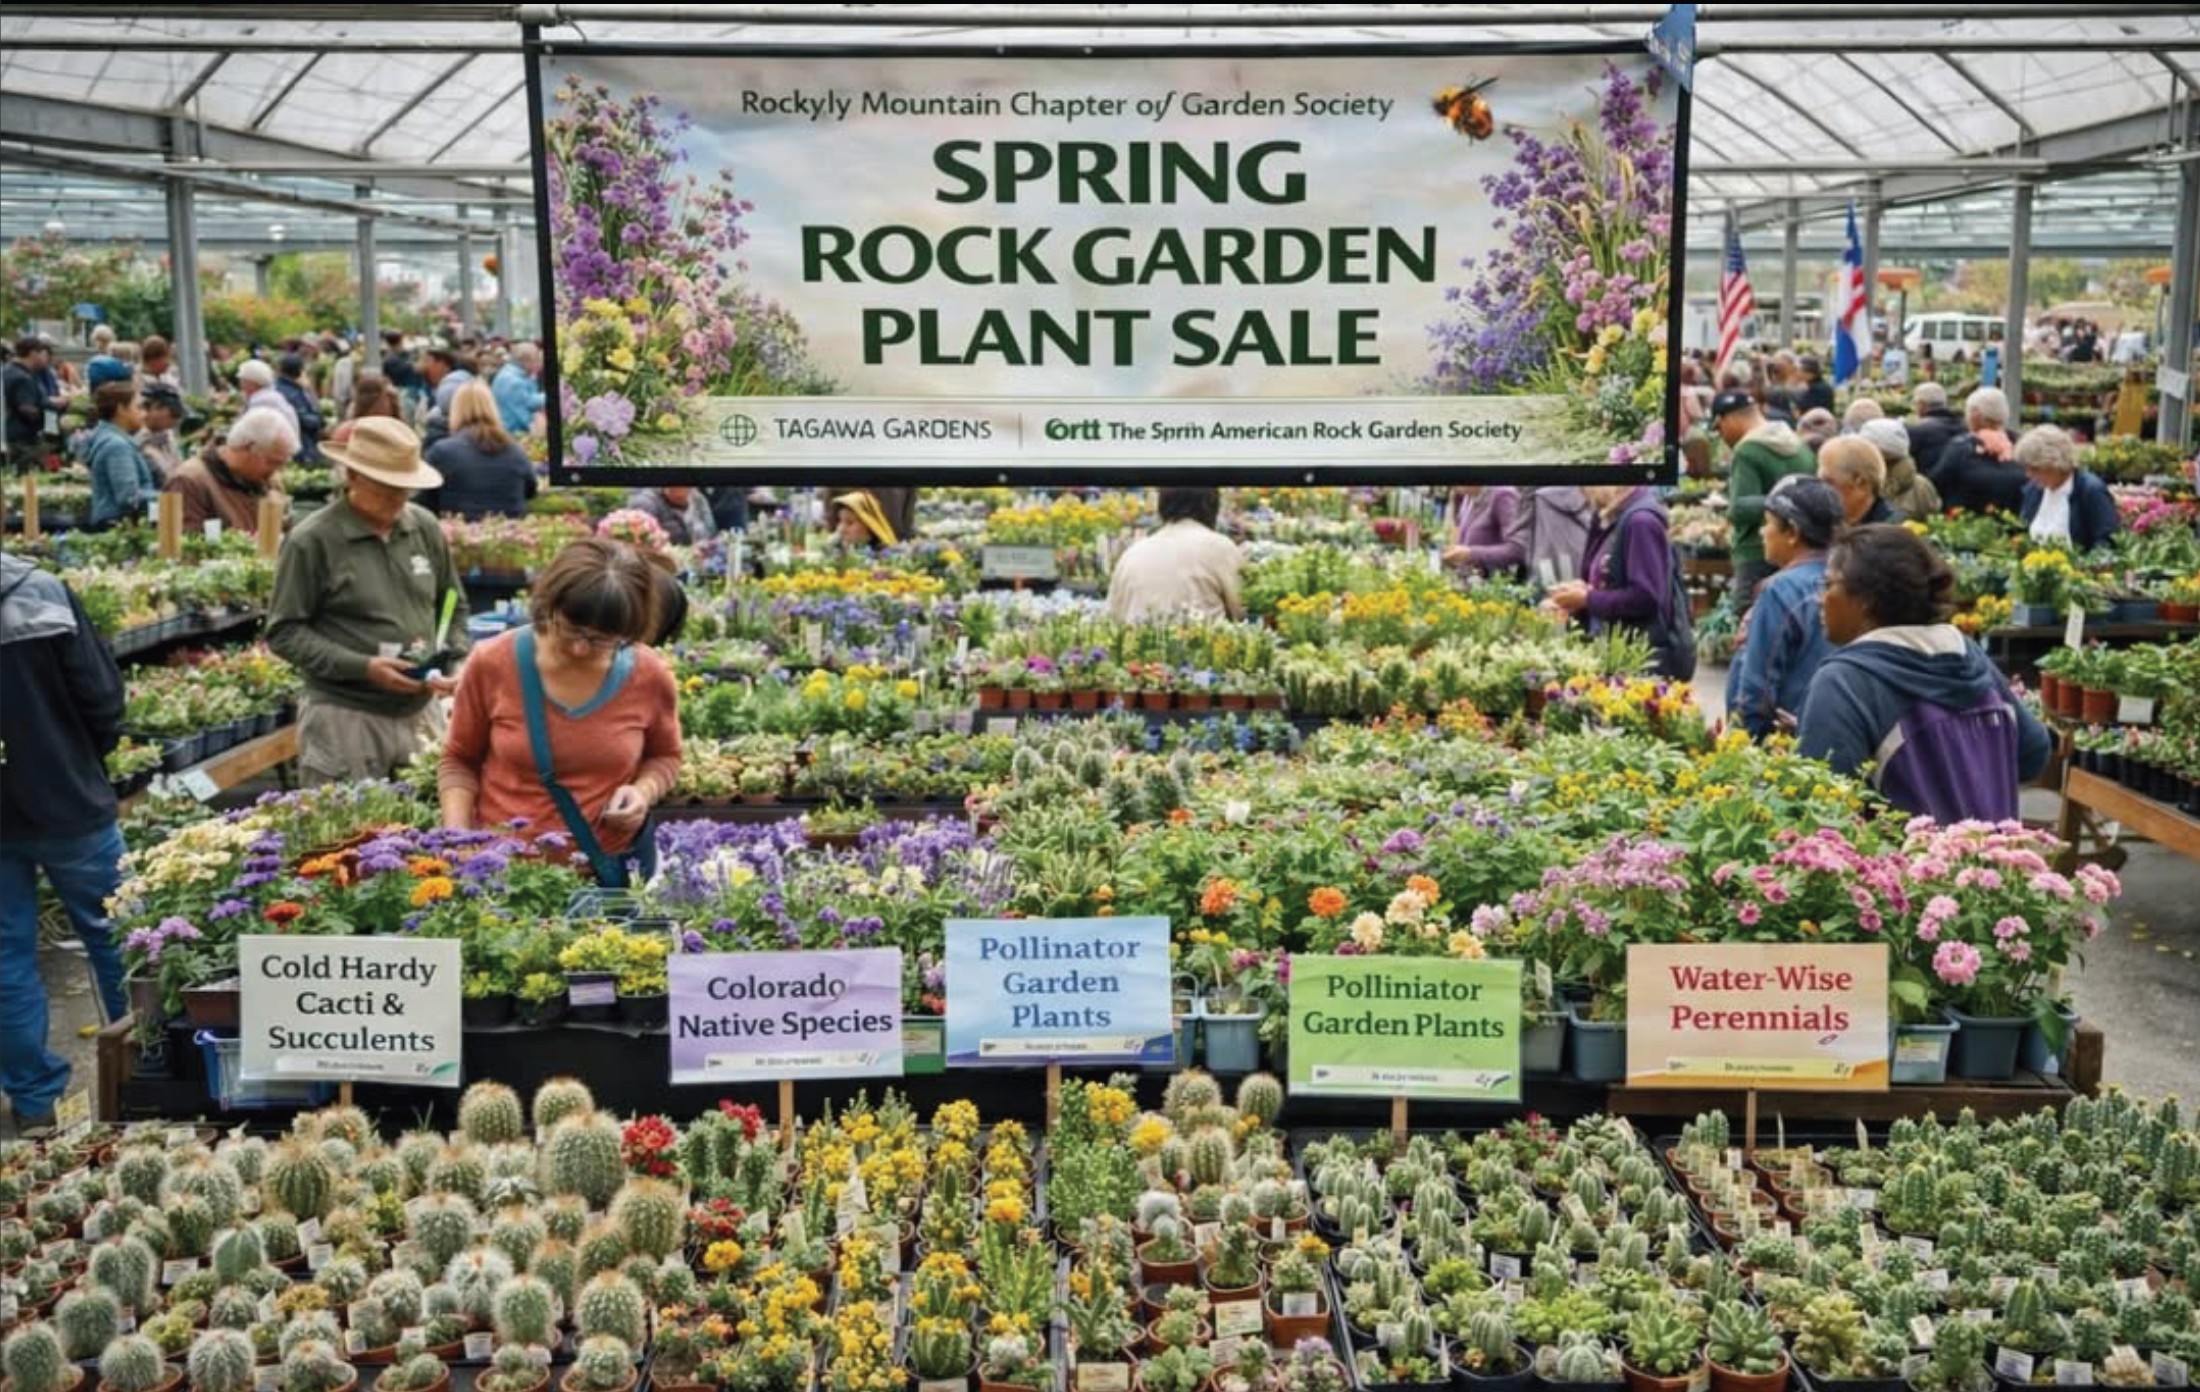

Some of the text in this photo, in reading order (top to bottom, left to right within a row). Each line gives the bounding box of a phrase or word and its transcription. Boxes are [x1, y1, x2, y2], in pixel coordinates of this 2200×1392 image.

[741, 89, 850, 122] Rockyly
[861, 90, 1001, 116] Mountain
[1011, 90, 1127, 122] Chapter
[1181, 90, 1285, 116] Garden
[1294, 90, 1395, 122] Society
[933, 140, 1307, 206] SPRING
[800, 224, 1437, 286] ROCK GARDEN
[862, 308, 1381, 367] PLANT SALE
[773, 418, 992, 440] TAGAWA GARDENS
[1108, 422, 1147, 440] The
[1210, 420, 1308, 439] American
[1313, 420, 1363, 440] Rock
[1368, 420, 1443, 440] Garden
[1448, 420, 1524, 444] Society
[979, 935, 1142, 961] Pollinator
[261, 954, 437, 987] Cold Hardy
[1003, 968, 1121, 994] Garden
[1669, 963, 1853, 991] Water-Wise
[707, 972, 846, 1002] Colorado
[1326, 974, 1484, 1001] Polliniator
[296, 991, 405, 1016] Cacti &
[1011, 1003, 1111, 1029] Plants
[679, 1009, 893, 1041] Native Species
[1303, 1010, 1505, 1038] Garden Plants
[1670, 1004, 1850, 1032] Perennials
[268, 1025, 435, 1051] Succulents
